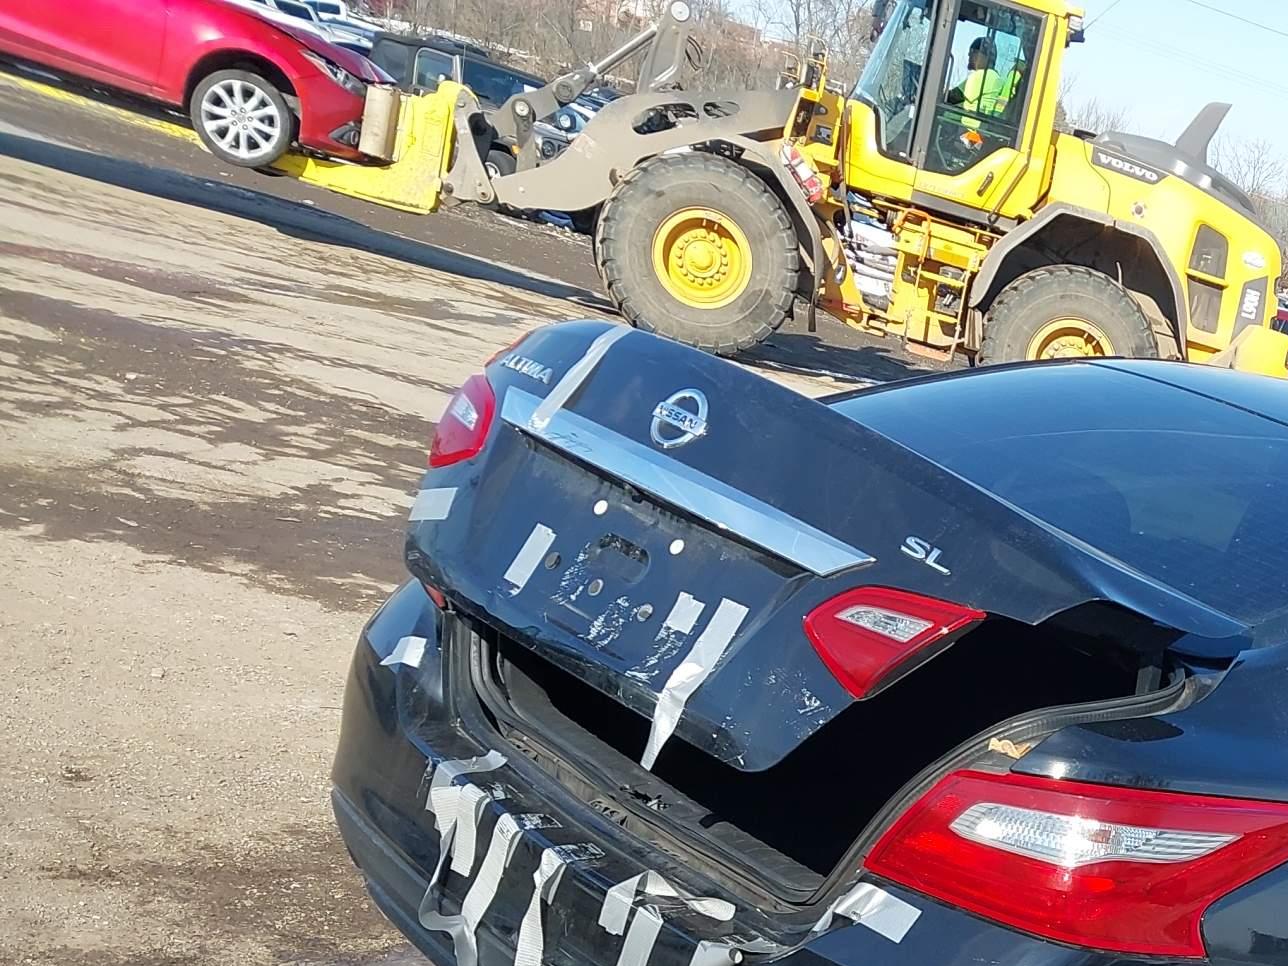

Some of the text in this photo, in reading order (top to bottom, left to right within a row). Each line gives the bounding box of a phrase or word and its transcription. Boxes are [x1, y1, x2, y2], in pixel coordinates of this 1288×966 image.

[1097, 152, 1158, 181] VOLVO
[500, 354, 553, 385] ALTIMA
[658, 403, 699, 430] NISSAN
[900, 536, 951, 576] SL
